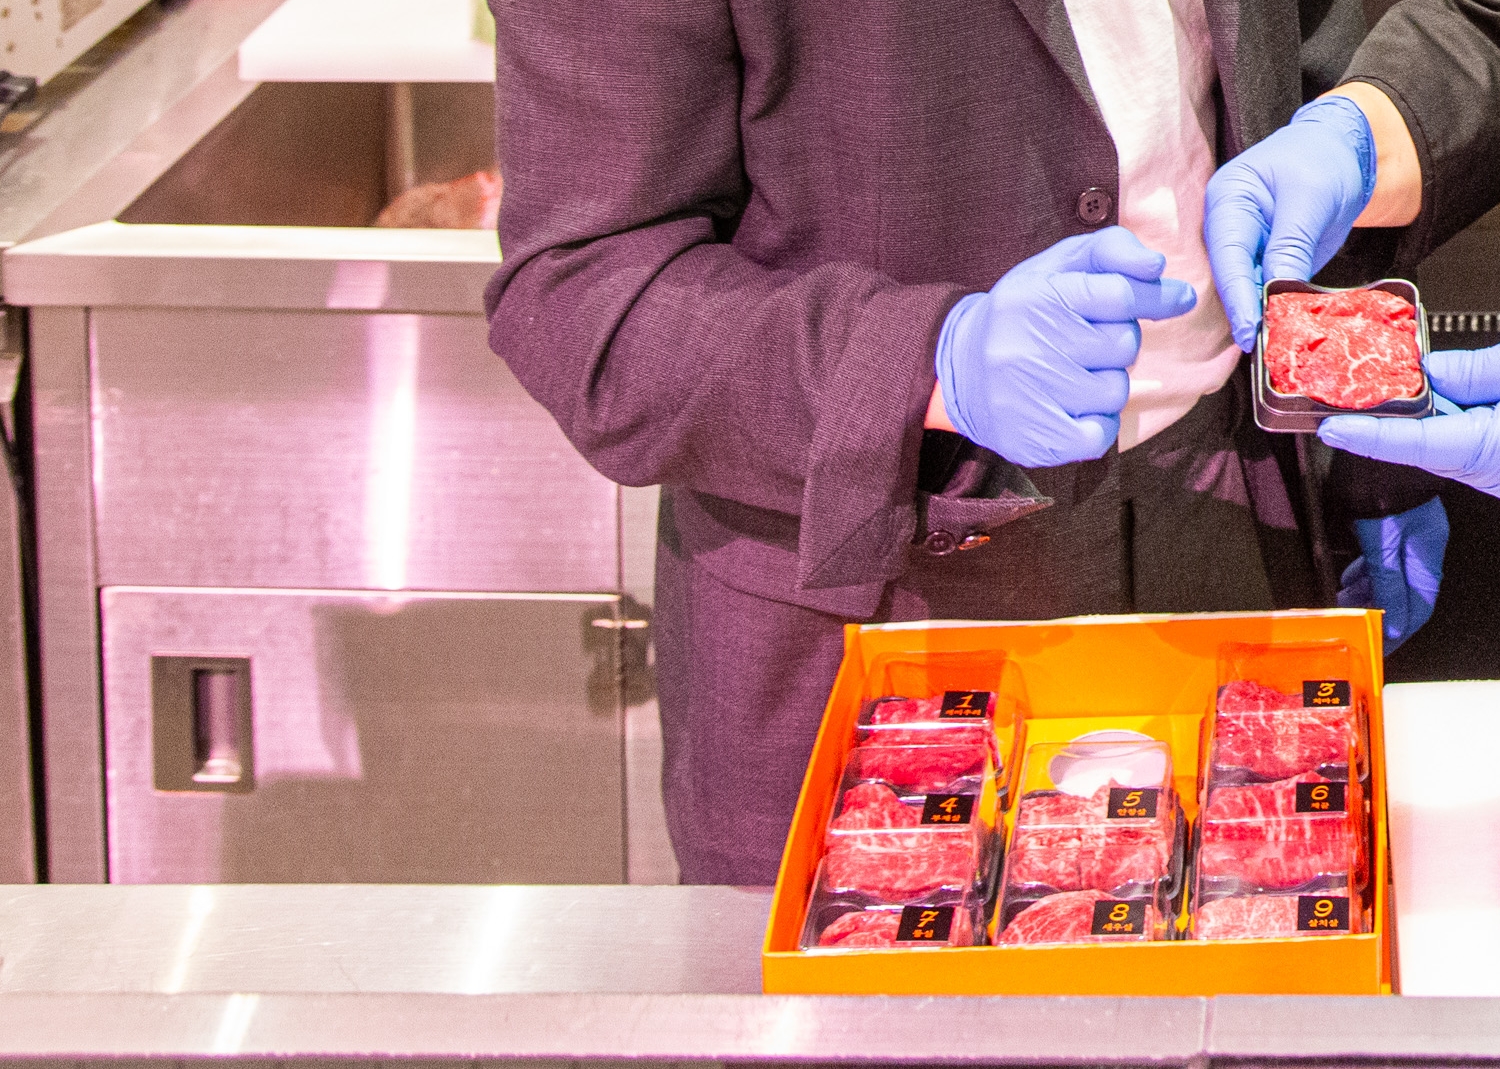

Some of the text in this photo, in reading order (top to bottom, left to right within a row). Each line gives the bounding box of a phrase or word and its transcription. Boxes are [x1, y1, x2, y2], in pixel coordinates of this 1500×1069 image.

[1317, 682, 1336, 697] 3
[955, 694, 974, 708] 1
[1122, 791, 1144, 807] 5
[1311, 785, 1329, 801] 6
[939, 797, 959, 813] 4
[1108, 903, 1130, 922] 8
[1313, 899, 1334, 918] 9
[917, 910, 940, 928] 7
[1307, 918, 1339, 928] 살치살
